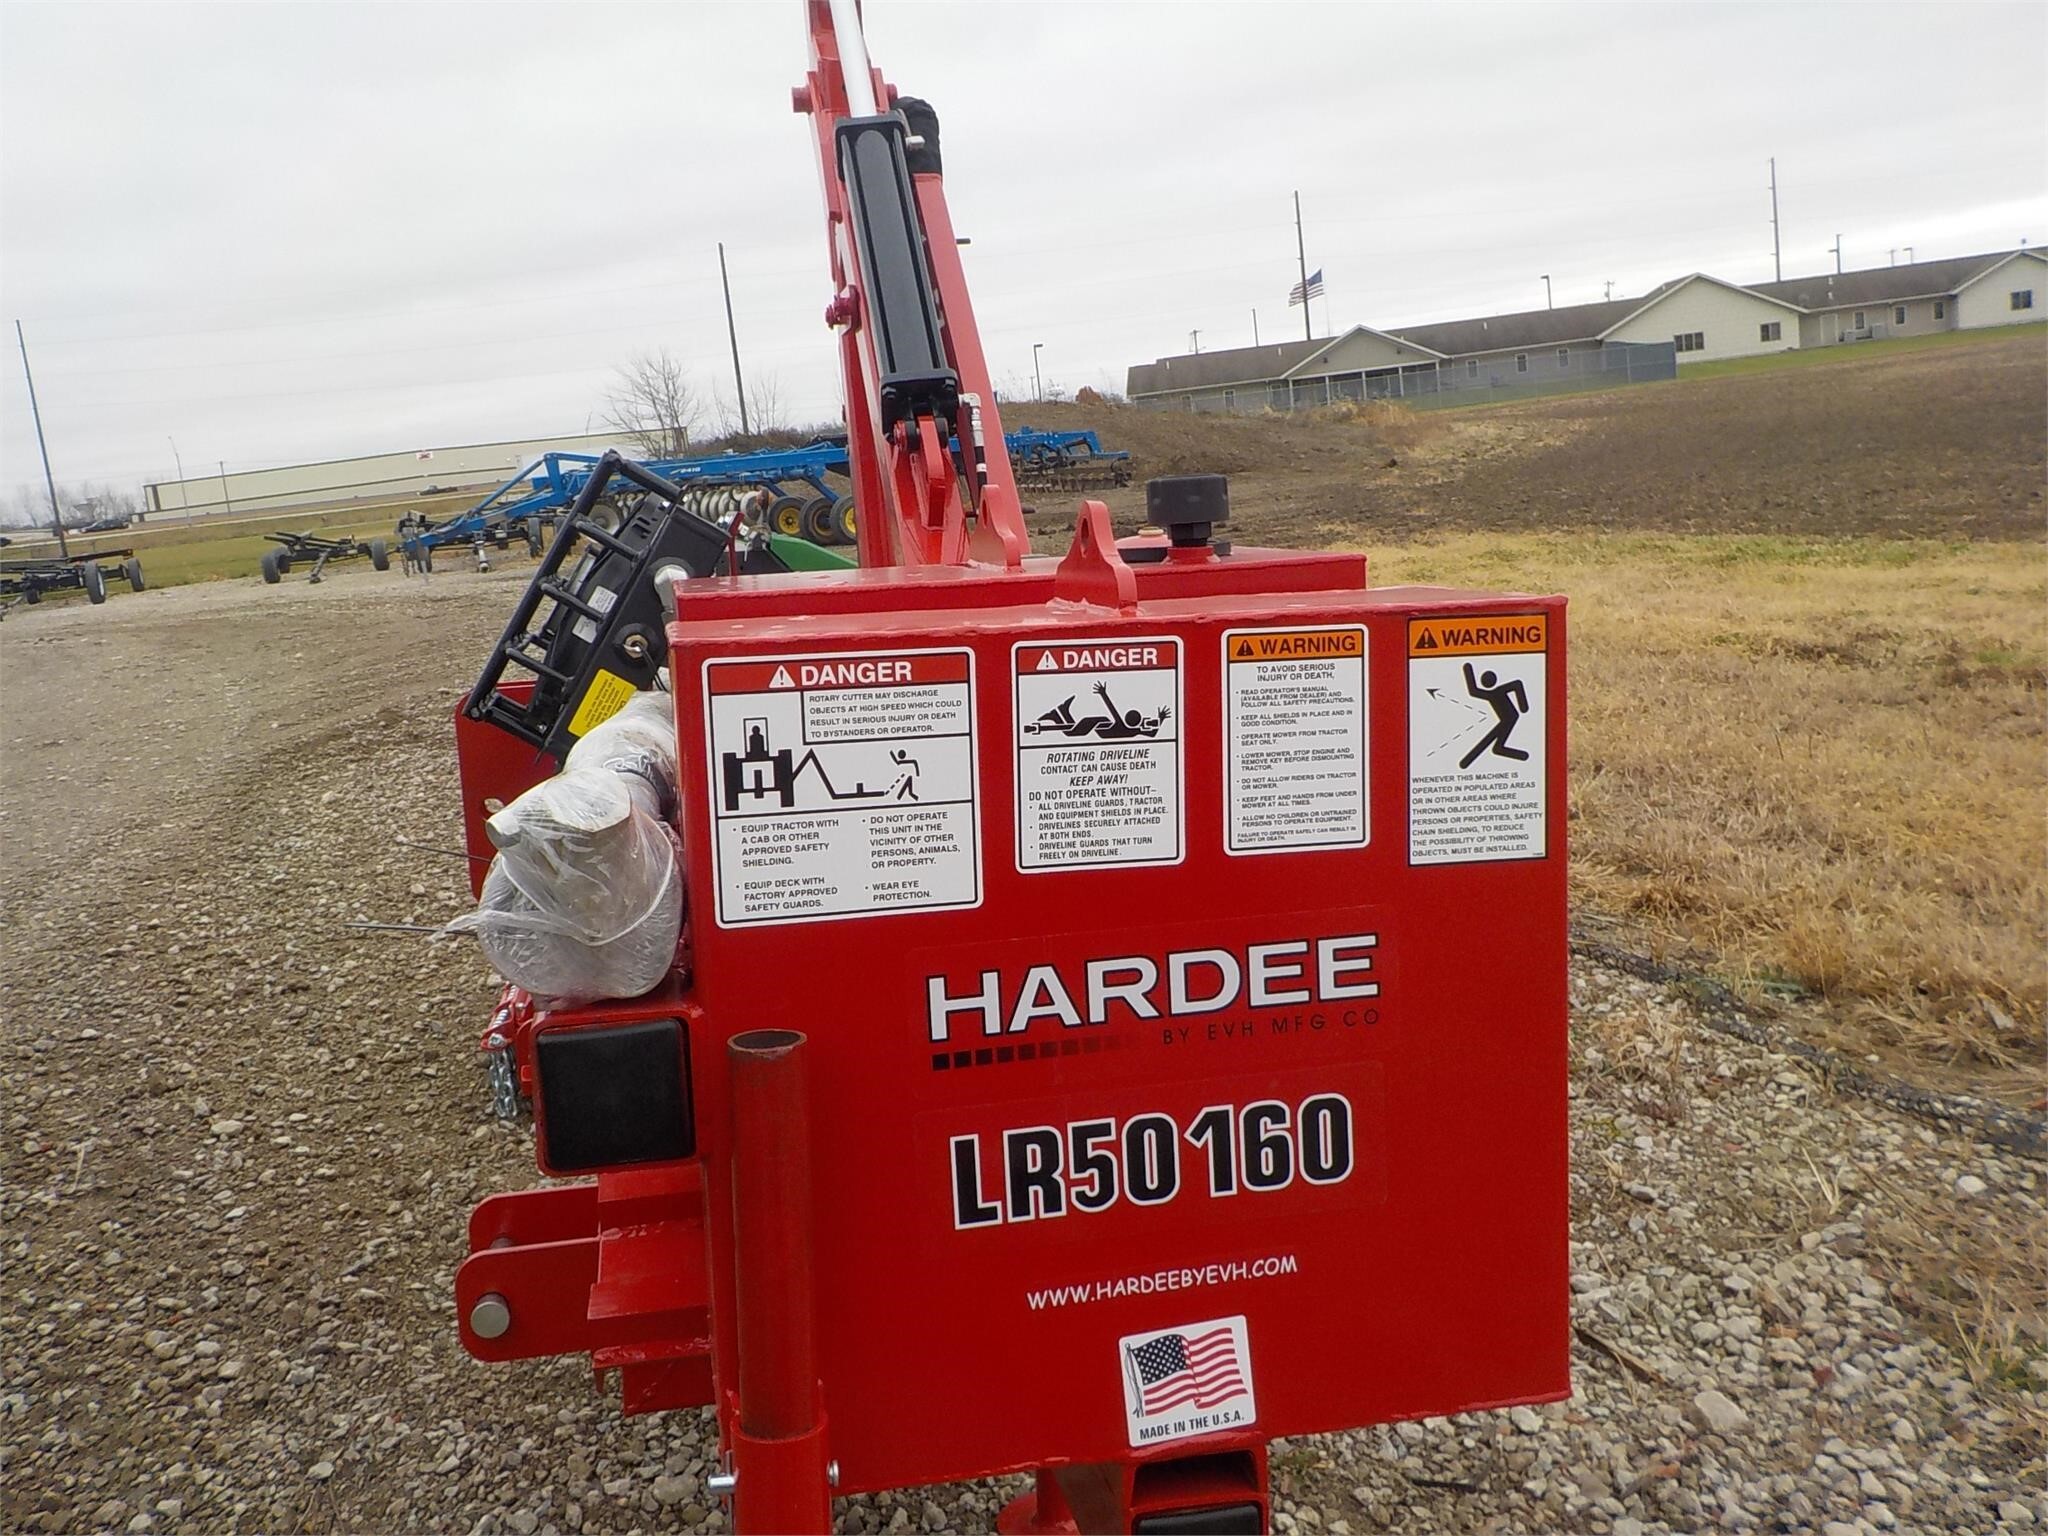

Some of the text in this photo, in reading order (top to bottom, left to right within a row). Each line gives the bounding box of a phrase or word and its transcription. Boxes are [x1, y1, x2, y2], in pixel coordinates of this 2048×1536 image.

[1441, 625, 1541, 646] WARNING
[1259, 635, 1356, 654] WARNING
[1063, 647, 1158, 668] DANGER
[801, 662, 912, 685] DANGER
[1256, 663, 1335, 674] TO AVOID SERIOUS
[1257, 673, 1287, 682] INJURY
[1289, 673, 1302, 681] OR
[809, 689, 938, 703] ROTARY CUTTER MAY DISCHARGE
[810, 700, 962, 714] OBJECTS AT HIGH SPEED WHICH COULD
[810, 712, 956, 726] RESULT IN SERIOUS INJURY OR DEATH
[811, 725, 934, 738] TO BYSTANDERS OR OPERATOR.
[1047, 749, 1150, 763] ROTATING DRIVELINE
[1041, 761, 1156, 775] CONTACT CAN CAUSE DEATH
[1069, 774, 1128, 786] KEEP AWAY!
[1412, 775, 1454, 784] WHENEVER
[1457, 774, 1473, 782] THIS
[1475, 772, 1509, 781] MACHINE
[1412, 785, 1452, 794] OPERATED
[1463, 783, 1508, 792] POPULATED
[1510, 781, 1535, 790] AREAS
[1029, 791, 1041, 801] DO
[1044, 790, 1062, 800] NOT
[1065, 788, 1106, 799] OPERATE
[1412, 797, 1423, 805] OR
[1434, 796, 1460, 804] OTHER
[1462, 794, 1487, 802] AREAS
[1489, 793, 1517, 801] WHERE
[1039, 797, 1163, 811] ALL DRIVELINE GUARDS, TRACTOR
[1412, 802, 1539, 815] THROWN OBJECTS COULD INJURE
[870, 812, 948, 824] DO NOT OPERATE
[1039, 806, 1169, 820] AND EQUIPMENT SHIELDS IN PLACE.
[1412, 817, 1448, 825] PERSONS
[1462, 814, 1512, 823] PROPERTIES,
[1514, 812, 1543, 820] SAFETY
[741, 819, 839, 833] EQUIP TRACTOR WITH
[869, 823, 942, 836] THIS UNIT IN THE
[1039, 817, 1161, 831] DRIVELINES SECURELY ATTACHED
[1412, 828, 1435, 836] CHAIN
[1437, 826, 1480, 835] SHIELDING,
[1493, 823, 1524, 832] REDUCE
[741, 832, 819, 844] A CAB OR OTHER
[870, 833, 954, 846] VICINITY OF OTHER
[1039, 830, 1094, 841] AT BOTH ENDS.
[1428, 836, 1474, 846] POSSIBILITY
[1489, 834, 1529, 842] THROWING
[742, 843, 830, 856] APPROVED SAFETY
[1039, 837, 1152, 850] DRIVELINE GUARDS THAT TURN
[871, 844, 960, 857] PERSONS, ANIMALS,
[1039, 848, 1122, 860] FREELY ON DRIVELINE.
[1412, 844, 1528, 857] OBJECTS, MUST BE INSTALLED.
[742, 857, 794, 868] SHIELDING.
[871, 857, 936, 869] OR PROPERTY.
[744, 877, 825, 890] EQUIP DECK WITH
[872, 880, 919, 891] WEAR EYE
[744, 887, 838, 900] FACTORY APPROVED
[873, 891, 932, 902] PROTECTION.
[745, 900, 824, 912] SAFETY GUARDS.
[926, 933, 1380, 1042] HARDEE
[1164, 1009, 1380, 1045] BY EVH MFG CO
[950, 1092, 1354, 1231] LR50160
[1027, 1254, 1298, 1310] WWW.HARDEEBYEVH.COM
[1138, 1410, 1246, 1440] MADE IN THE U.S.A.
